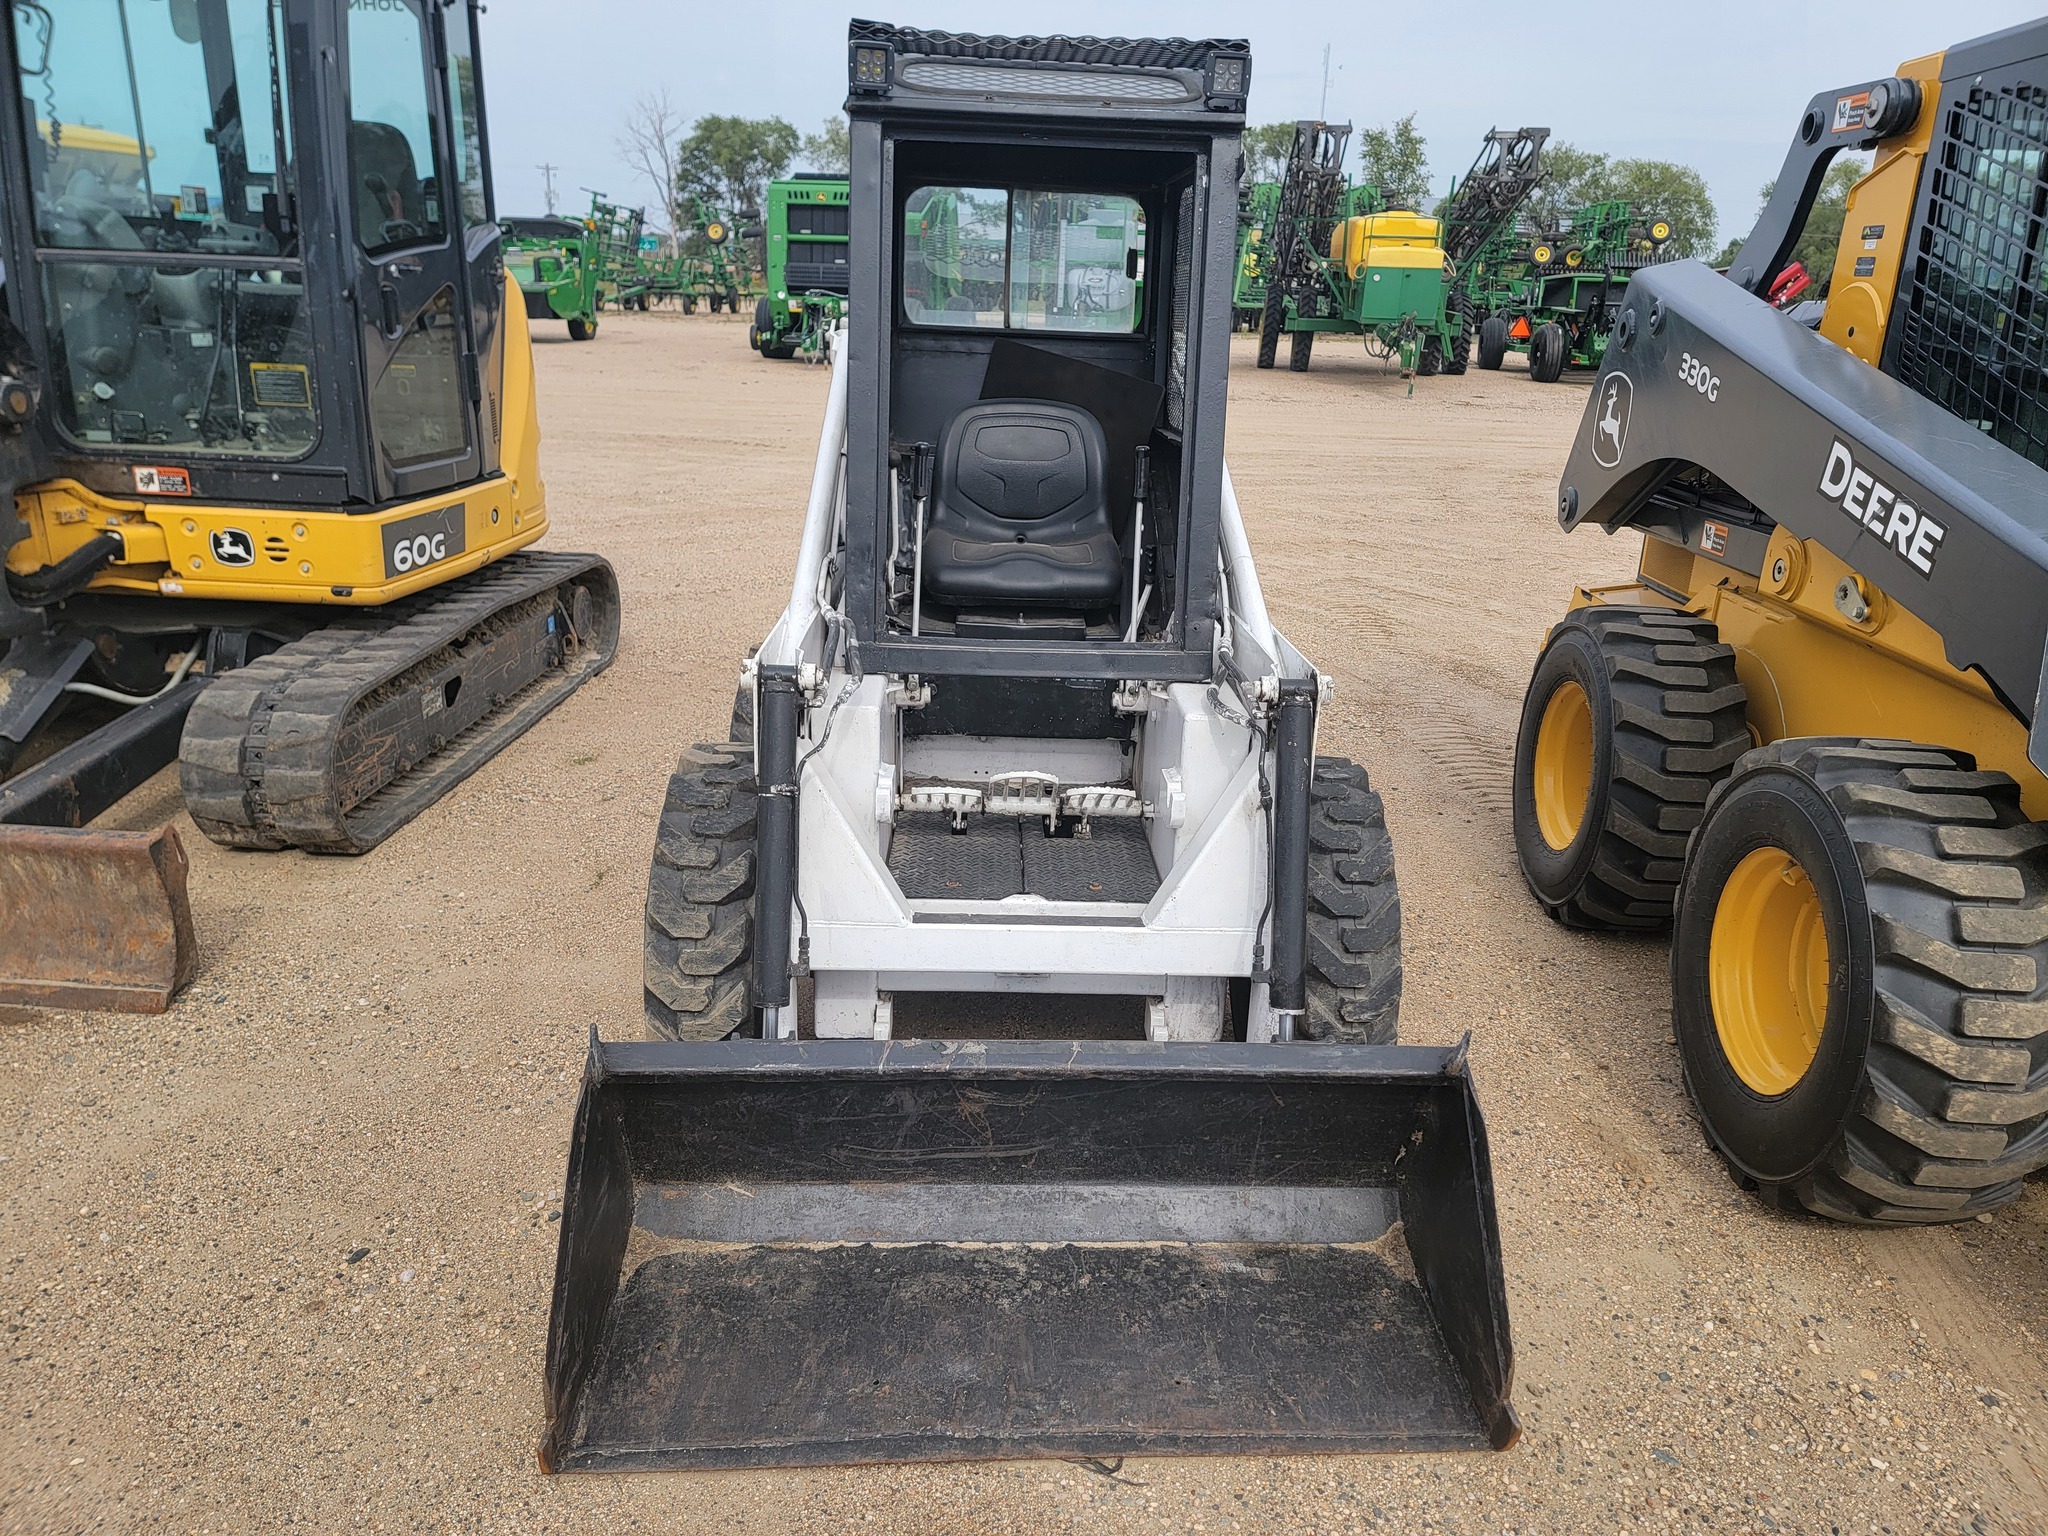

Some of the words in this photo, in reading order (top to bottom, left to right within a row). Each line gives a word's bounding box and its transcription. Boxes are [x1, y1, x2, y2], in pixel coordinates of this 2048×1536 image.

[1678, 352, 1720, 402] 330G
[1820, 441, 1944, 574] DEERE
[394, 533, 446, 572] 60G
